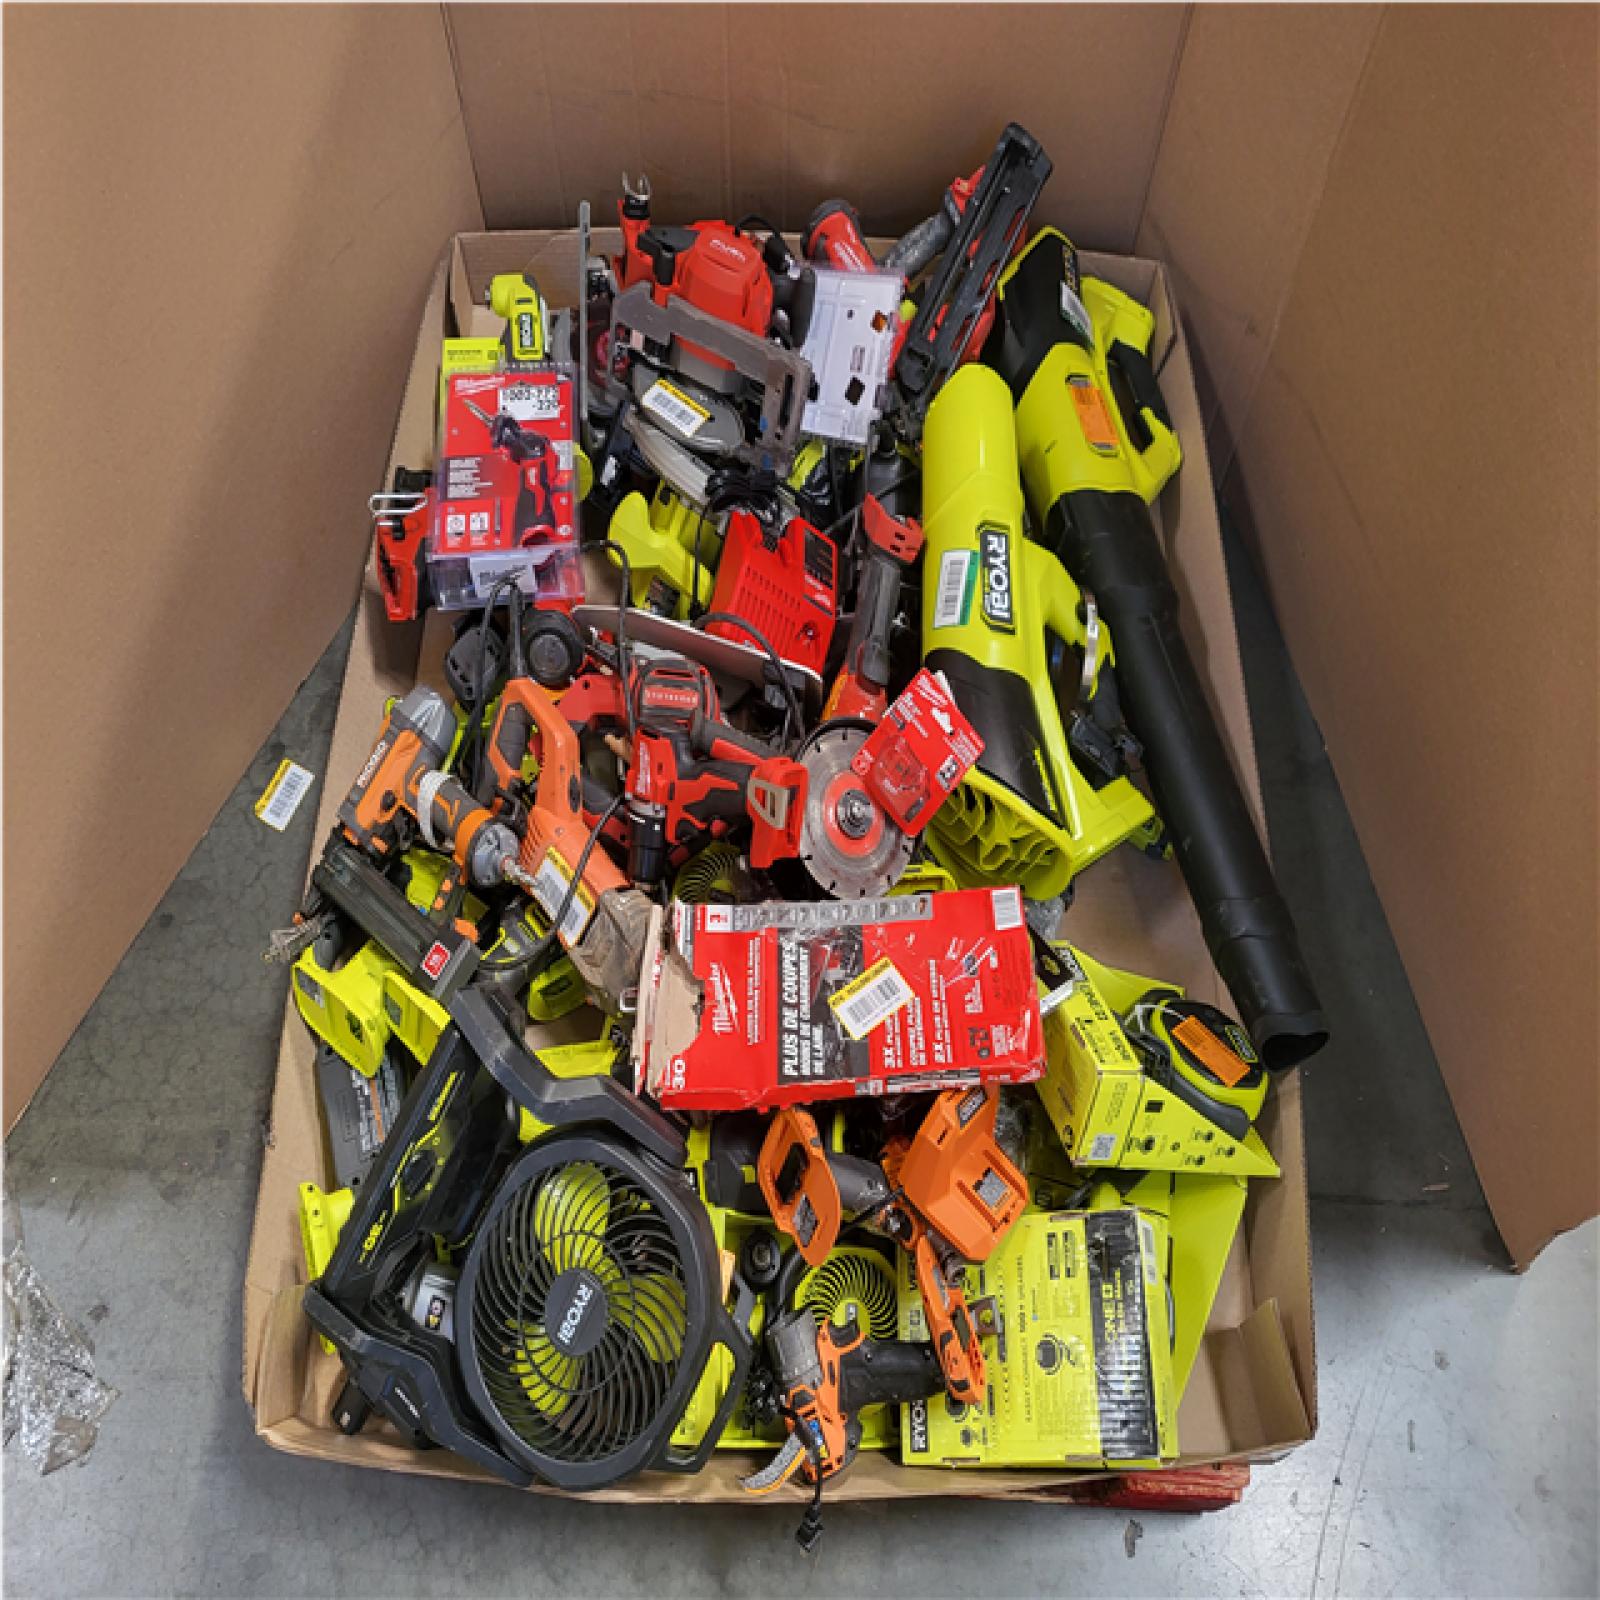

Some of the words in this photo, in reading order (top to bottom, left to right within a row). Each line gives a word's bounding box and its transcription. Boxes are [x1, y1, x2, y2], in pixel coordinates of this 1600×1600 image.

[985, 534, 1010, 619] RYOBI
[781, 1006, 799, 1031] DE
[781, 1032, 799, 1076] PLUS
[557, 1281, 594, 1345] RYOBI
